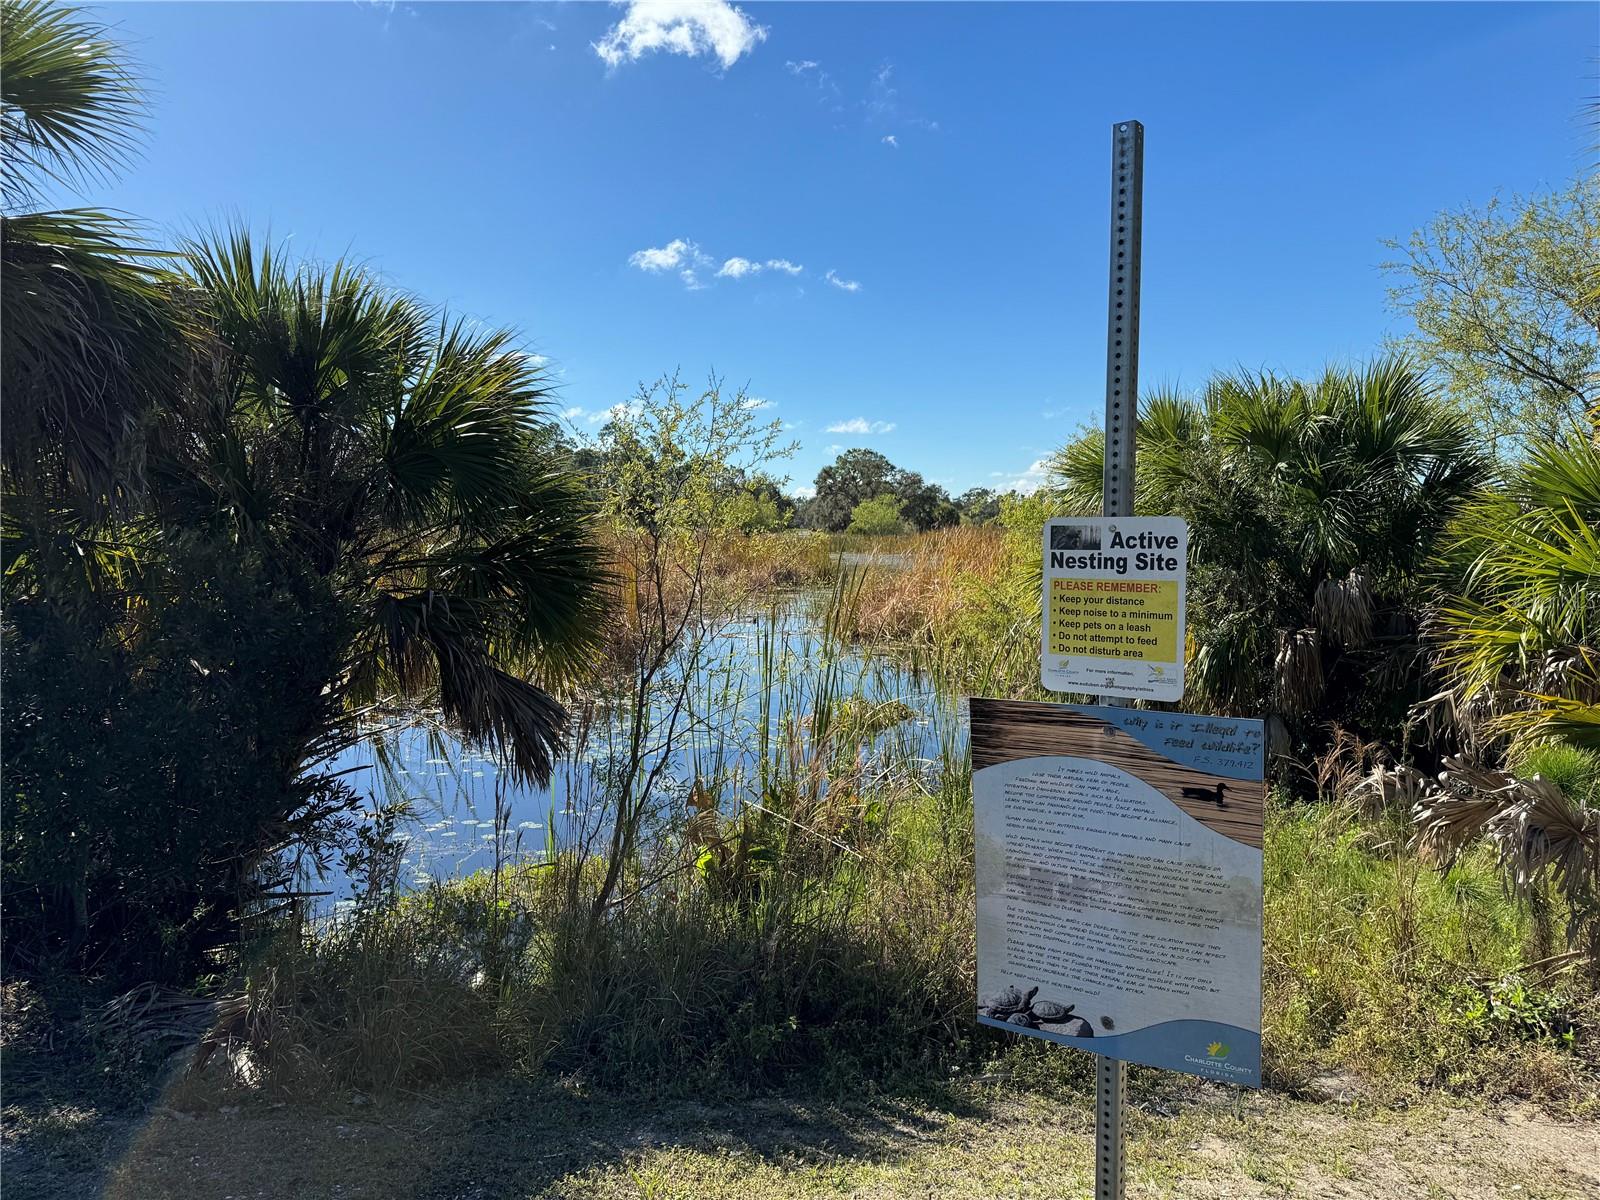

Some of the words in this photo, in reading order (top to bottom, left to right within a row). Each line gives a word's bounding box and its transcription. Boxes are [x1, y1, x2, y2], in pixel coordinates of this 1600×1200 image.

[1110, 532, 1178, 549] Active
[1051, 552, 1128, 574] Nesting
[1135, 553, 1178, 571] Site
[1054, 581, 1092, 591] PLEASE
[1096, 582, 1162, 593] REMEMBER:
[1059, 594, 1081, 605] Keep
[1083, 597, 1103, 605] your
[1106, 596, 1144, 606] distance
[1059, 607, 1081, 617] Keep
[1083, 608, 1107, 617] noise
[1110, 610, 1118, 618] to
[1130, 610, 1172, 620] minimum
[1059, 620, 1080, 630] Keep
[1083, 621, 1102, 630] pets
[1126, 622, 1151, 632] leash
[1058, 632, 1070, 640] Do
[1073, 633, 1087, 641] not
[1090, 634, 1123, 645] attempt
[1126, 635, 1134, 644] to
[1137, 635, 1158, 646] feed
[1058, 644, 1070, 652] Do
[1089, 645, 1121, 656] disturb
[1155, 720, 1163, 729] is
[1190, 722, 1238, 738] Illegal
[1218, 759, 1254, 769] 379.412
[1185, 1055, 1221, 1067] CHARLOTTE
[1224, 1063, 1252, 1074] COUNTY
[1201, 1068, 1233, 1078] FLORIDA
